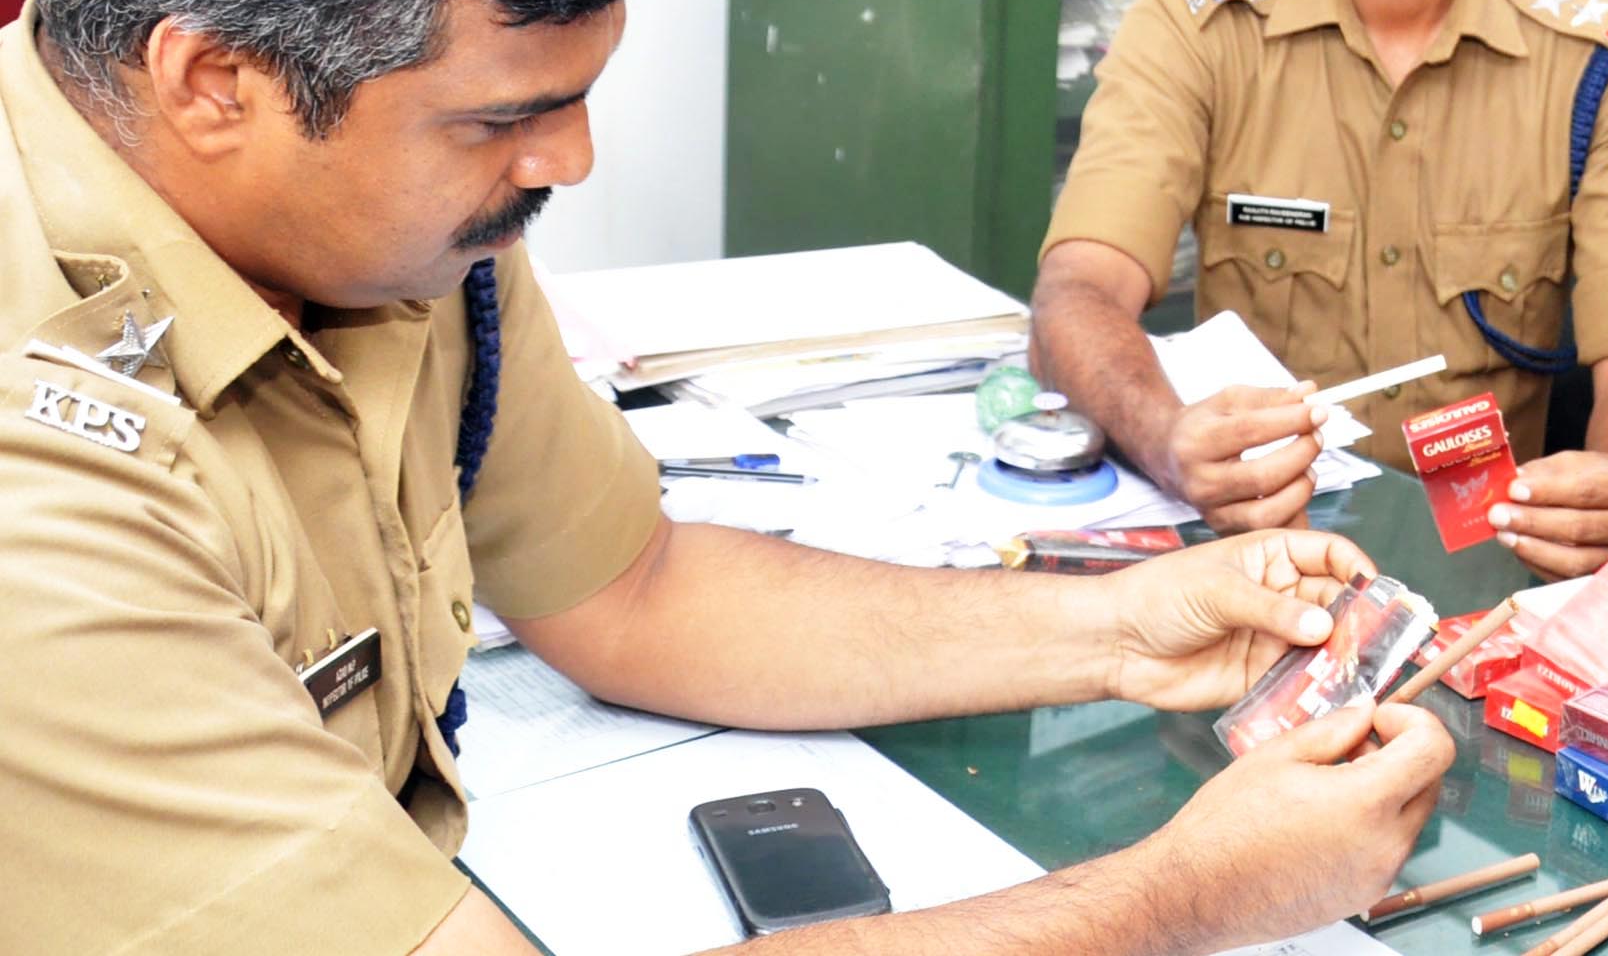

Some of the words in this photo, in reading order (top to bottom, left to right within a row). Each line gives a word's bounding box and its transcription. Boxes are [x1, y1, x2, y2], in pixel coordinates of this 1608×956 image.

[24, 378, 147, 452] KPS
[1423, 425, 1493, 458] GAULOISES
[748, 823, 798, 836] SAMSUNG
